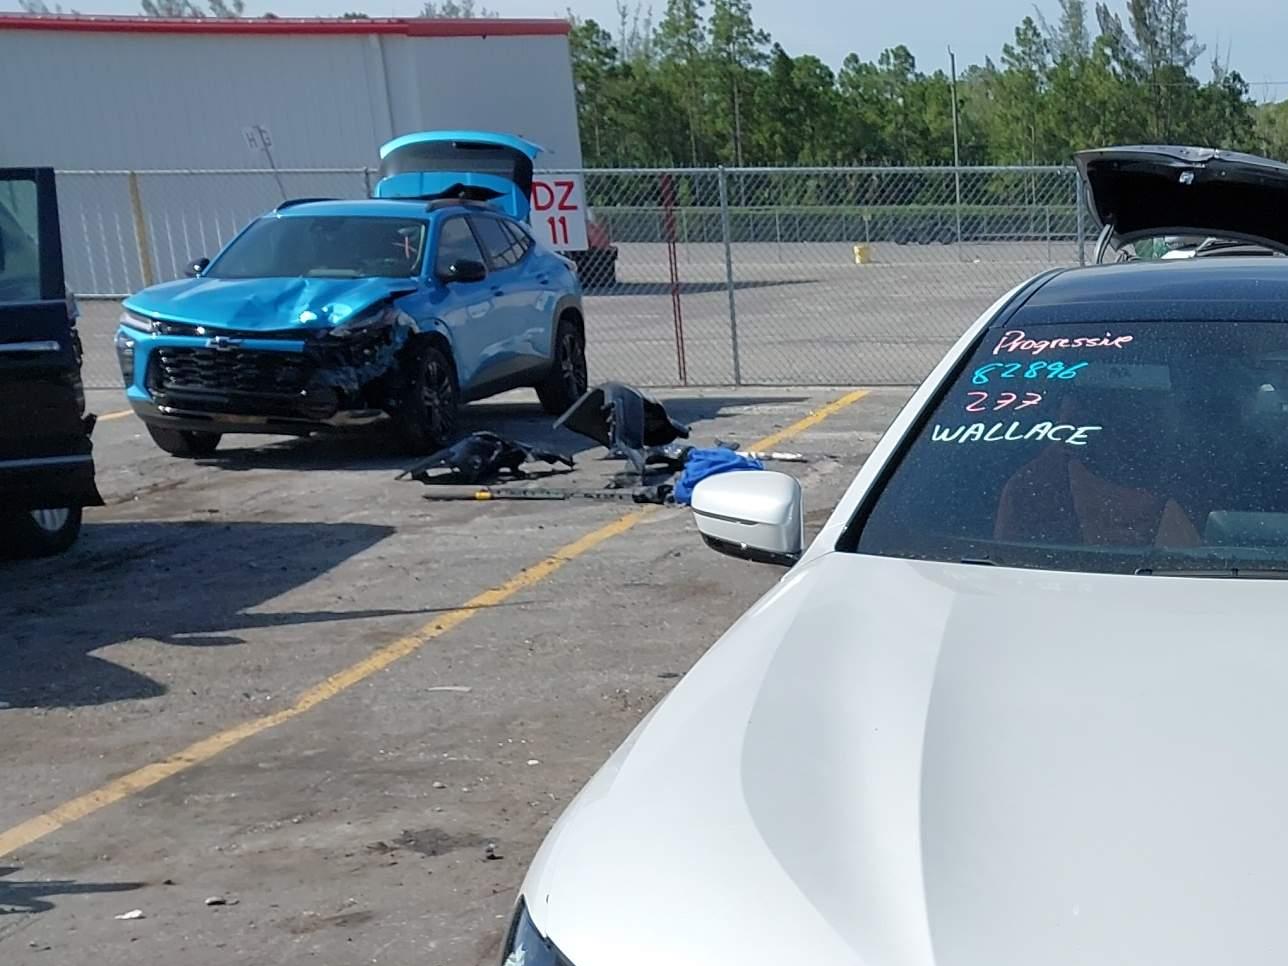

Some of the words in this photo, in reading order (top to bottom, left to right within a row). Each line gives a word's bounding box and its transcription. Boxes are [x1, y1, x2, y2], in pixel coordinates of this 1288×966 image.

[531, 181, 578, 211] DZ
[547, 216, 569, 245] 11
[971, 361, 1089, 385] 82896
[931, 421, 1103, 445] WALLACE
